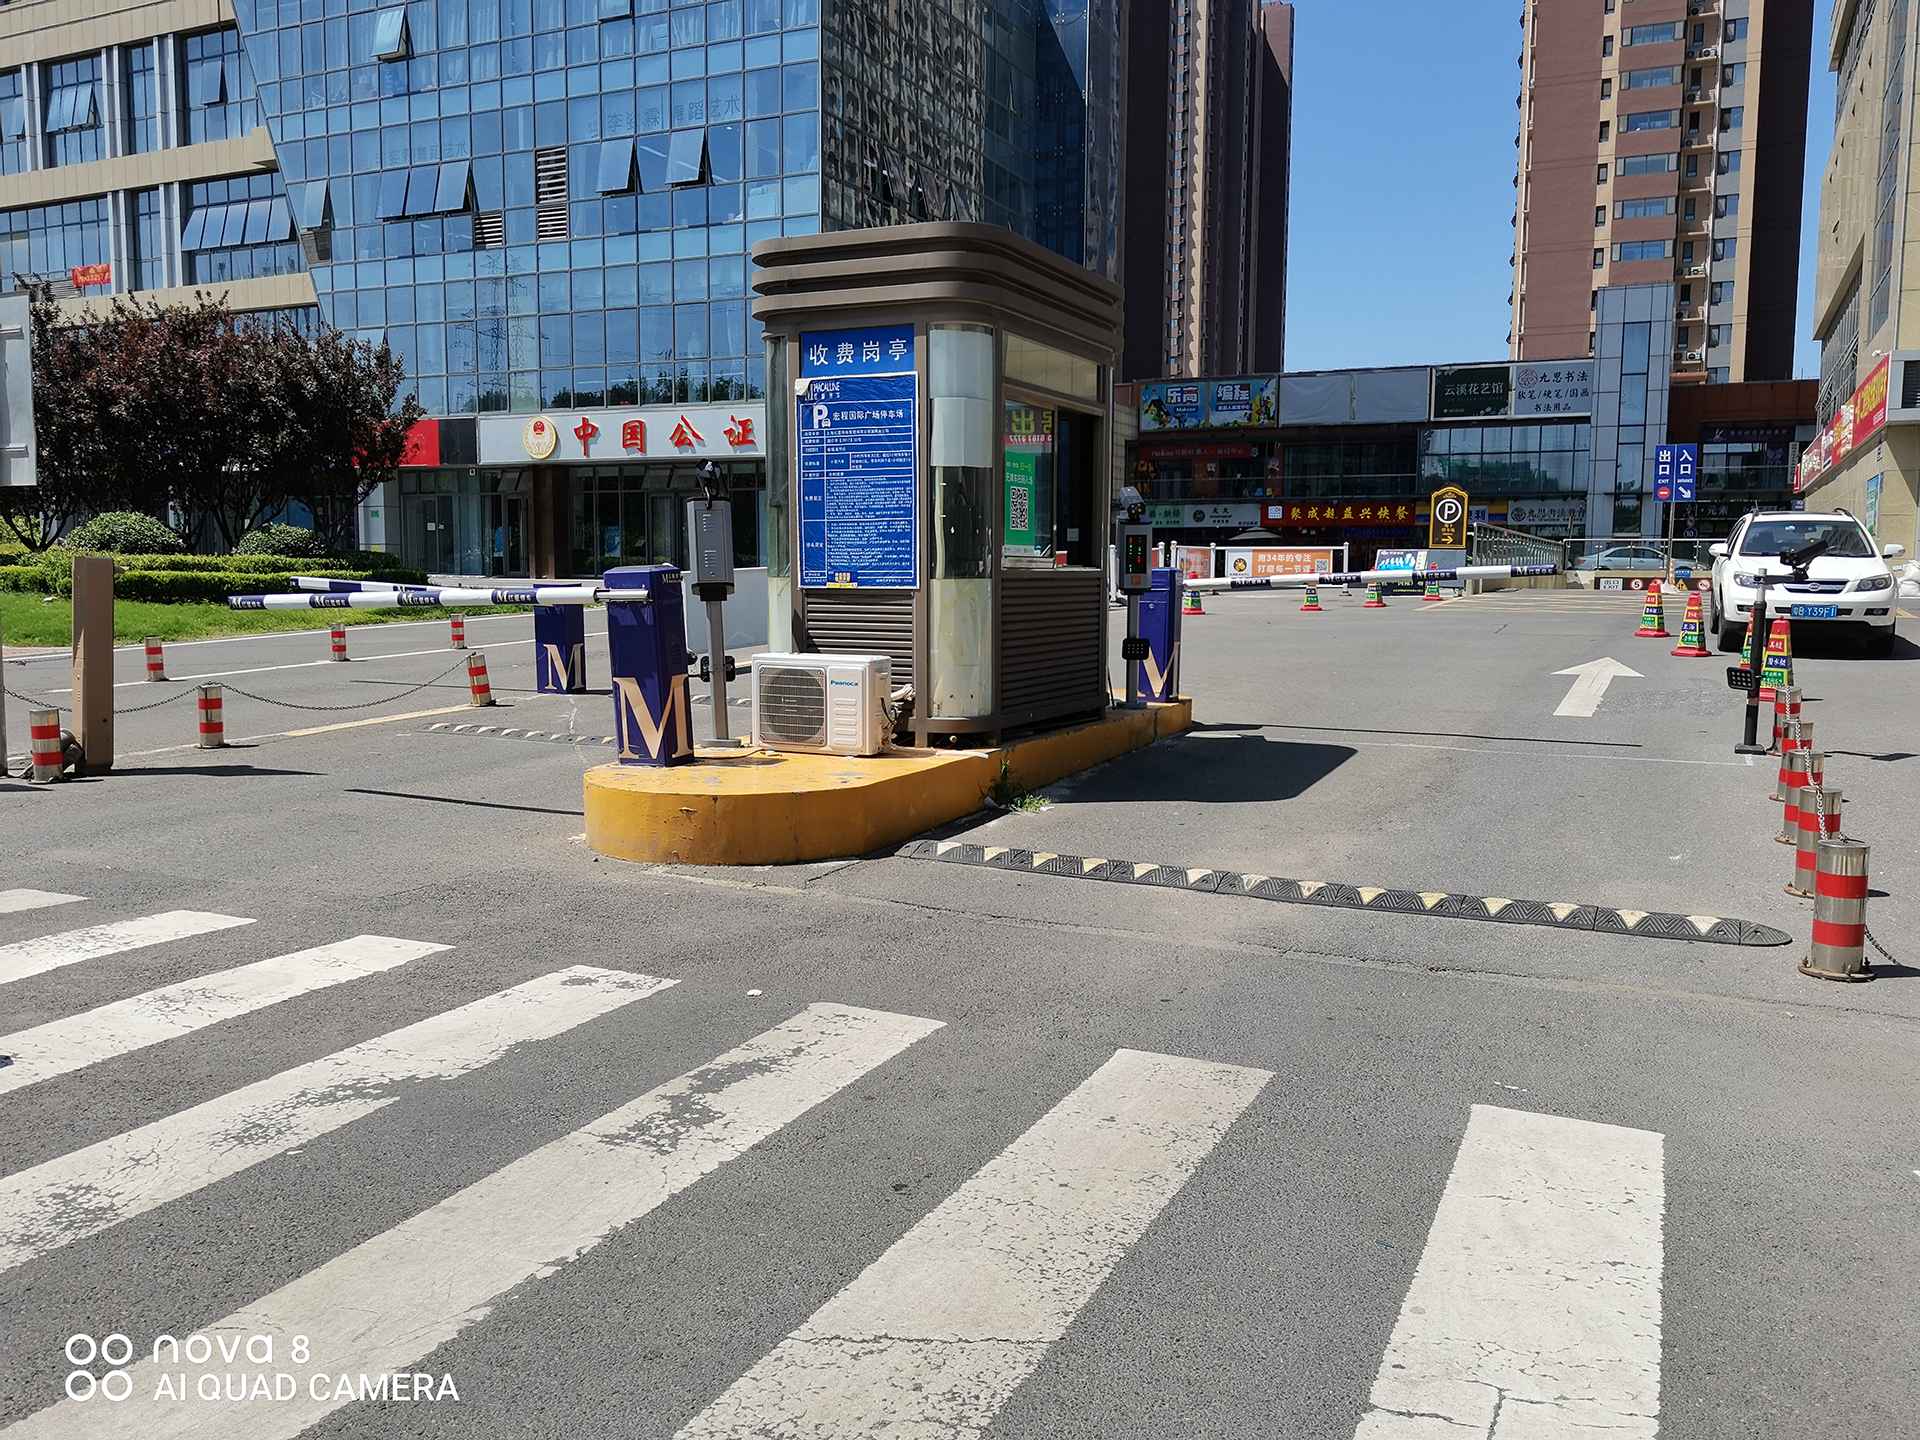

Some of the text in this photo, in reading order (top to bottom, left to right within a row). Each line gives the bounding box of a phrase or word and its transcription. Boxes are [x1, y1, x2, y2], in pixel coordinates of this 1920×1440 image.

[809, 338, 907, 366] 收费岗亭
[1539, 370, 1588, 384] 九思书法
[1166, 386, 1200, 404] 乐高
[1217, 384, 1250, 402] 编程
[1444, 381, 1504, 397] 云溪花艺馆
[1516, 388, 1590, 401] 软笔/硬笔/国画
[1533, 402, 1571, 413] 书法用品
[574, 414, 757, 457] 中国公证
[1658, 450, 1671, 476] 出口
[1679, 449, 1693, 475] 入口
[1258, 554, 1312, 562] 用34年的专注
